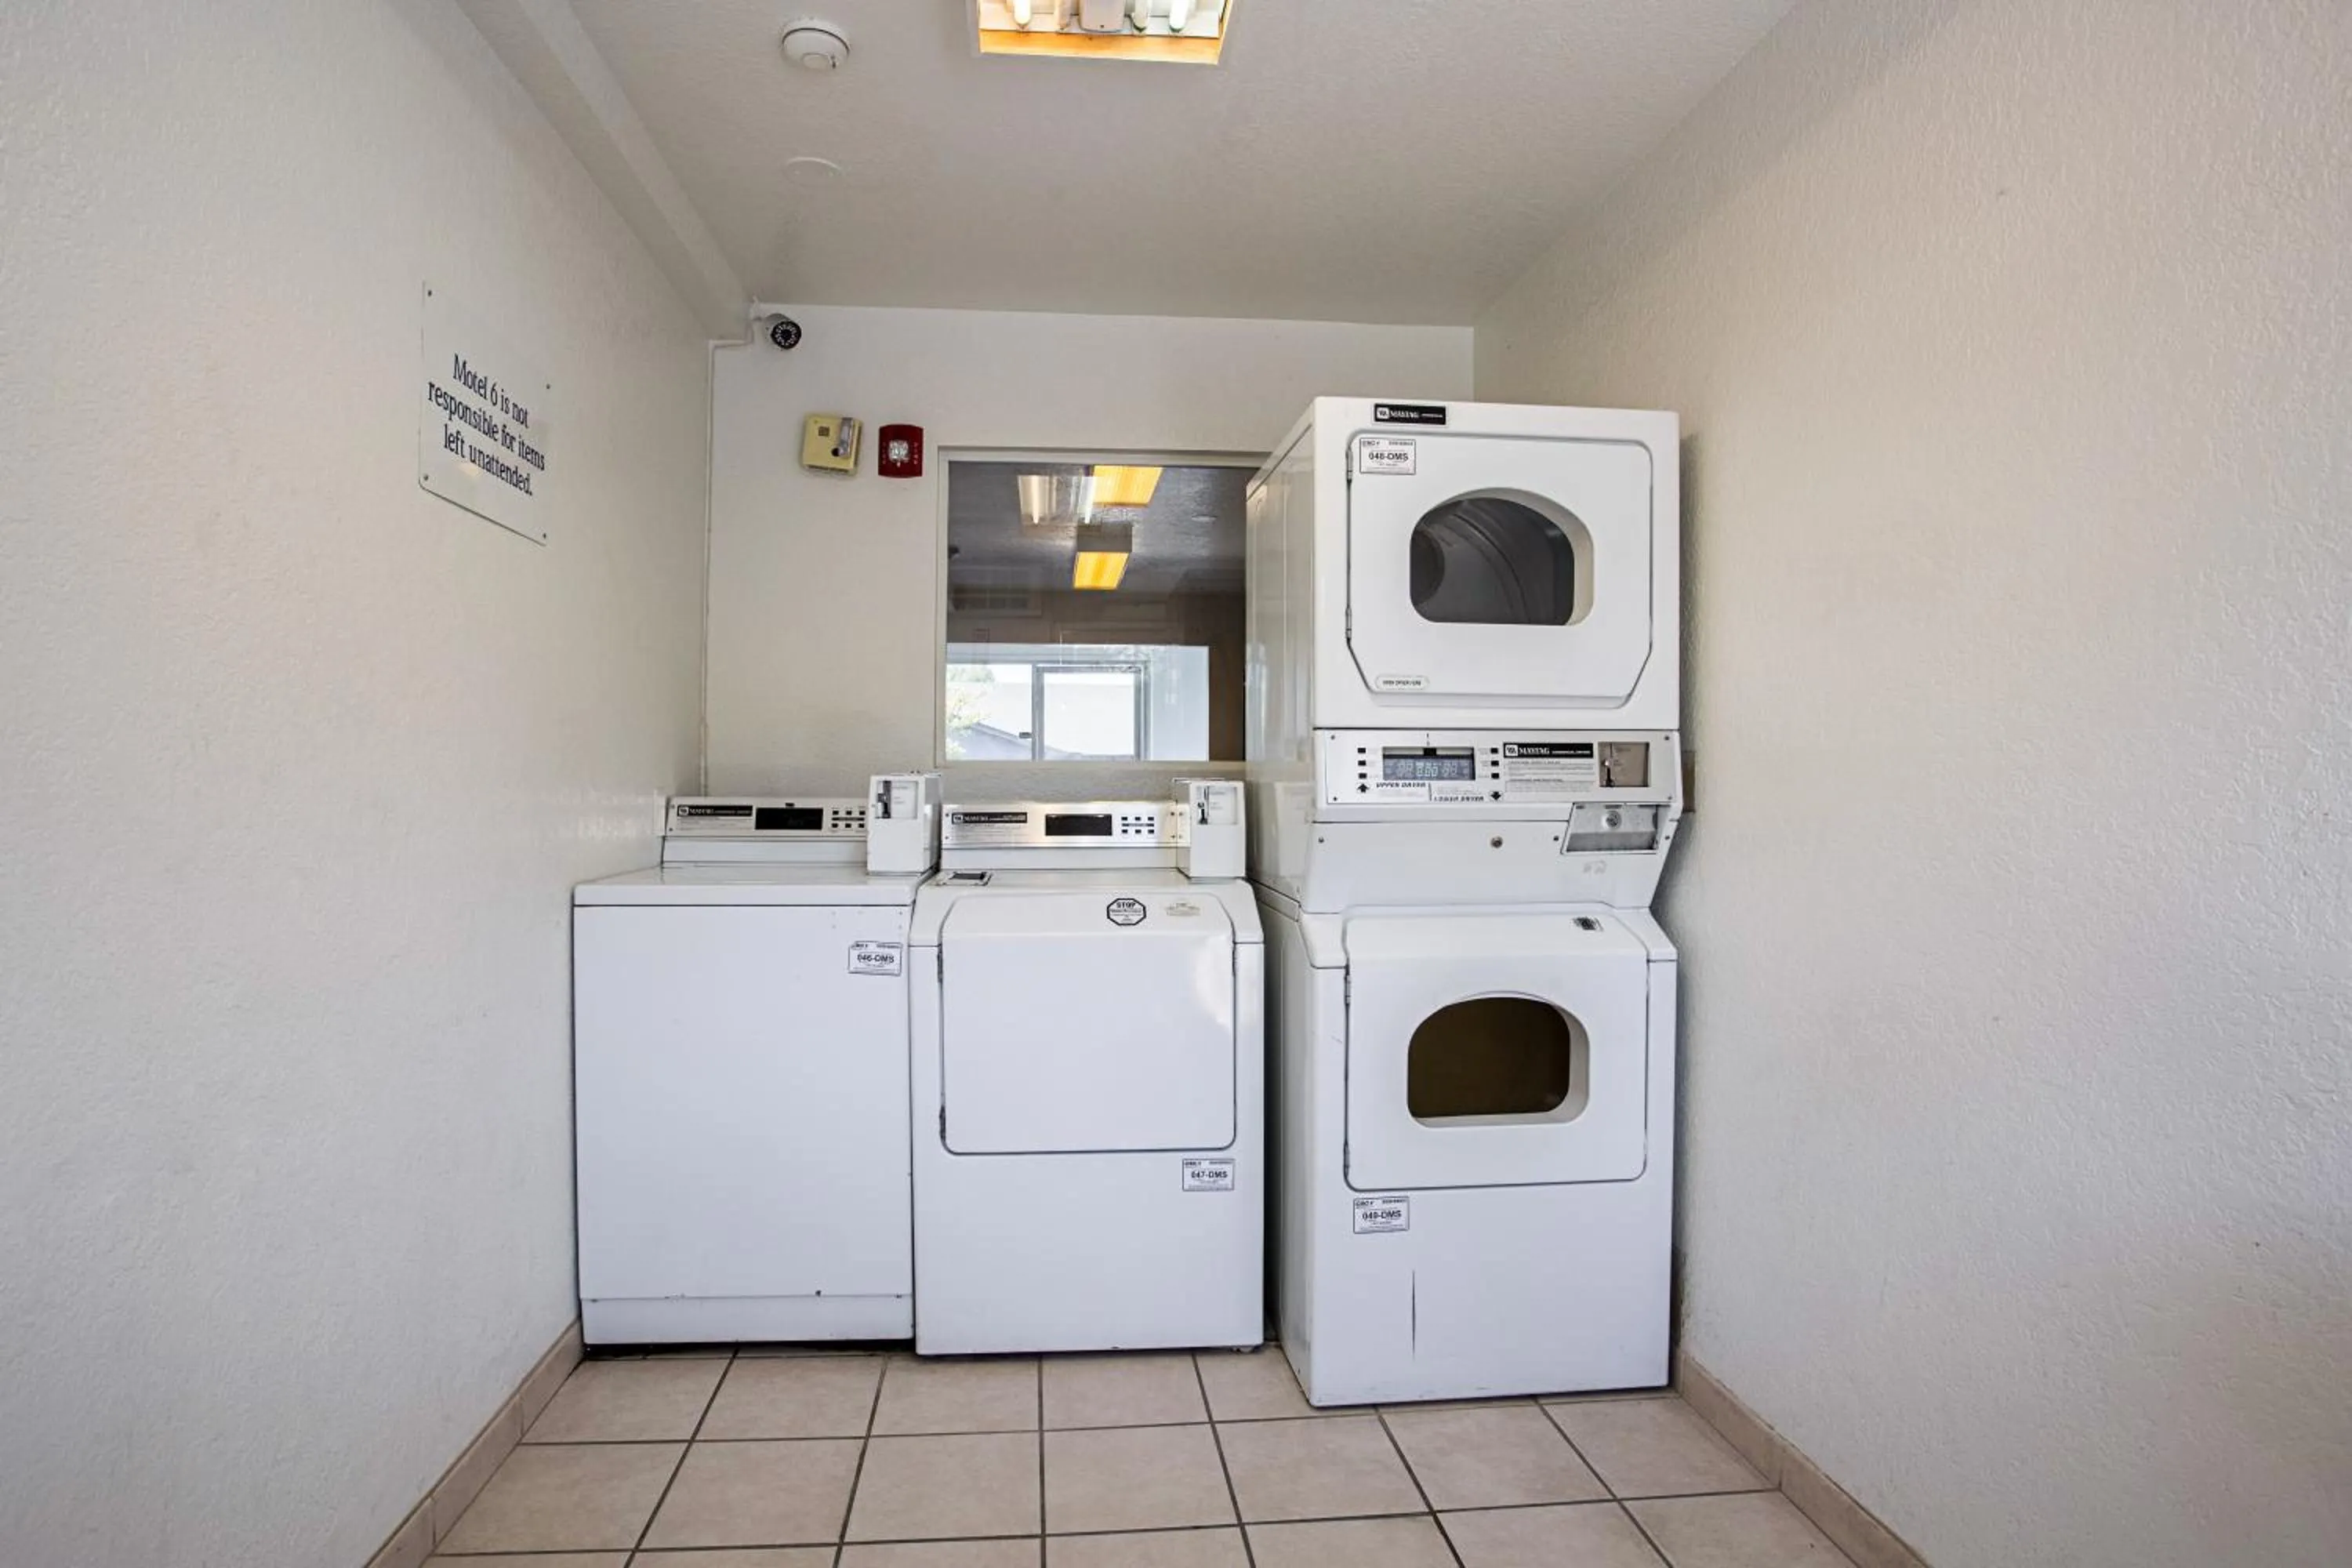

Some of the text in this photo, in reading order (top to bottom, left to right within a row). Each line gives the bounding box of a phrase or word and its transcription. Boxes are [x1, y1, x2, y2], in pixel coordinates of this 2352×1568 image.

[428, 381, 546, 472] responsible for items
[452, 353, 529, 429] Motel 6 is not
[444, 423, 533, 496] left unattended.
